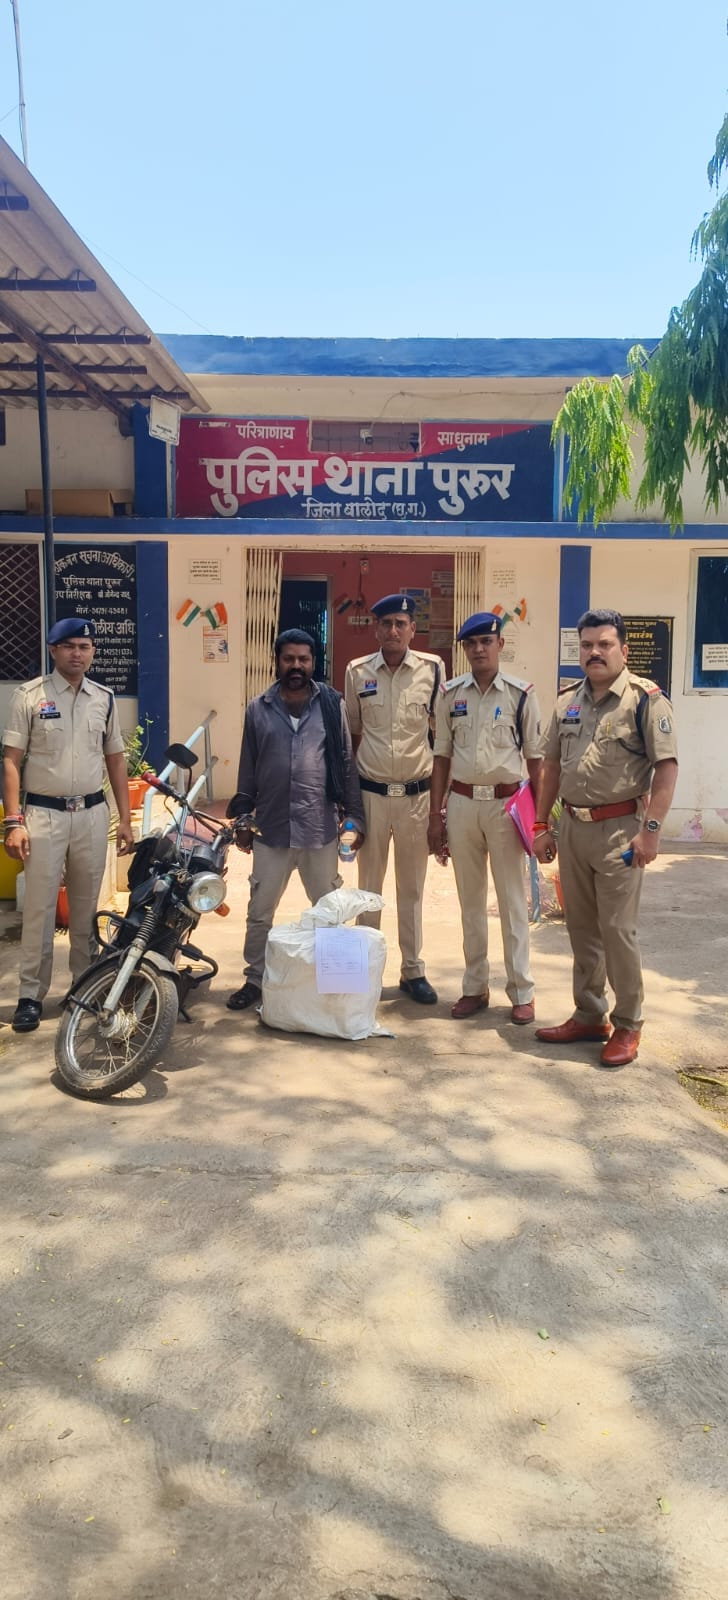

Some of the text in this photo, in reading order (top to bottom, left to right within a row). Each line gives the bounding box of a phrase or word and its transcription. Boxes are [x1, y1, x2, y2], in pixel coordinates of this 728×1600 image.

[236, 421, 295, 439] परित्राणाय
[437, 431, 491, 451] साधुनाम
[202, 446, 319, 517] पुलिस
[324, 456, 425, 496] थाना
[301, 497, 342, 518] जिला
[62, 574, 85, 588] पुलिस
[86, 577, 103, 586] थाना
